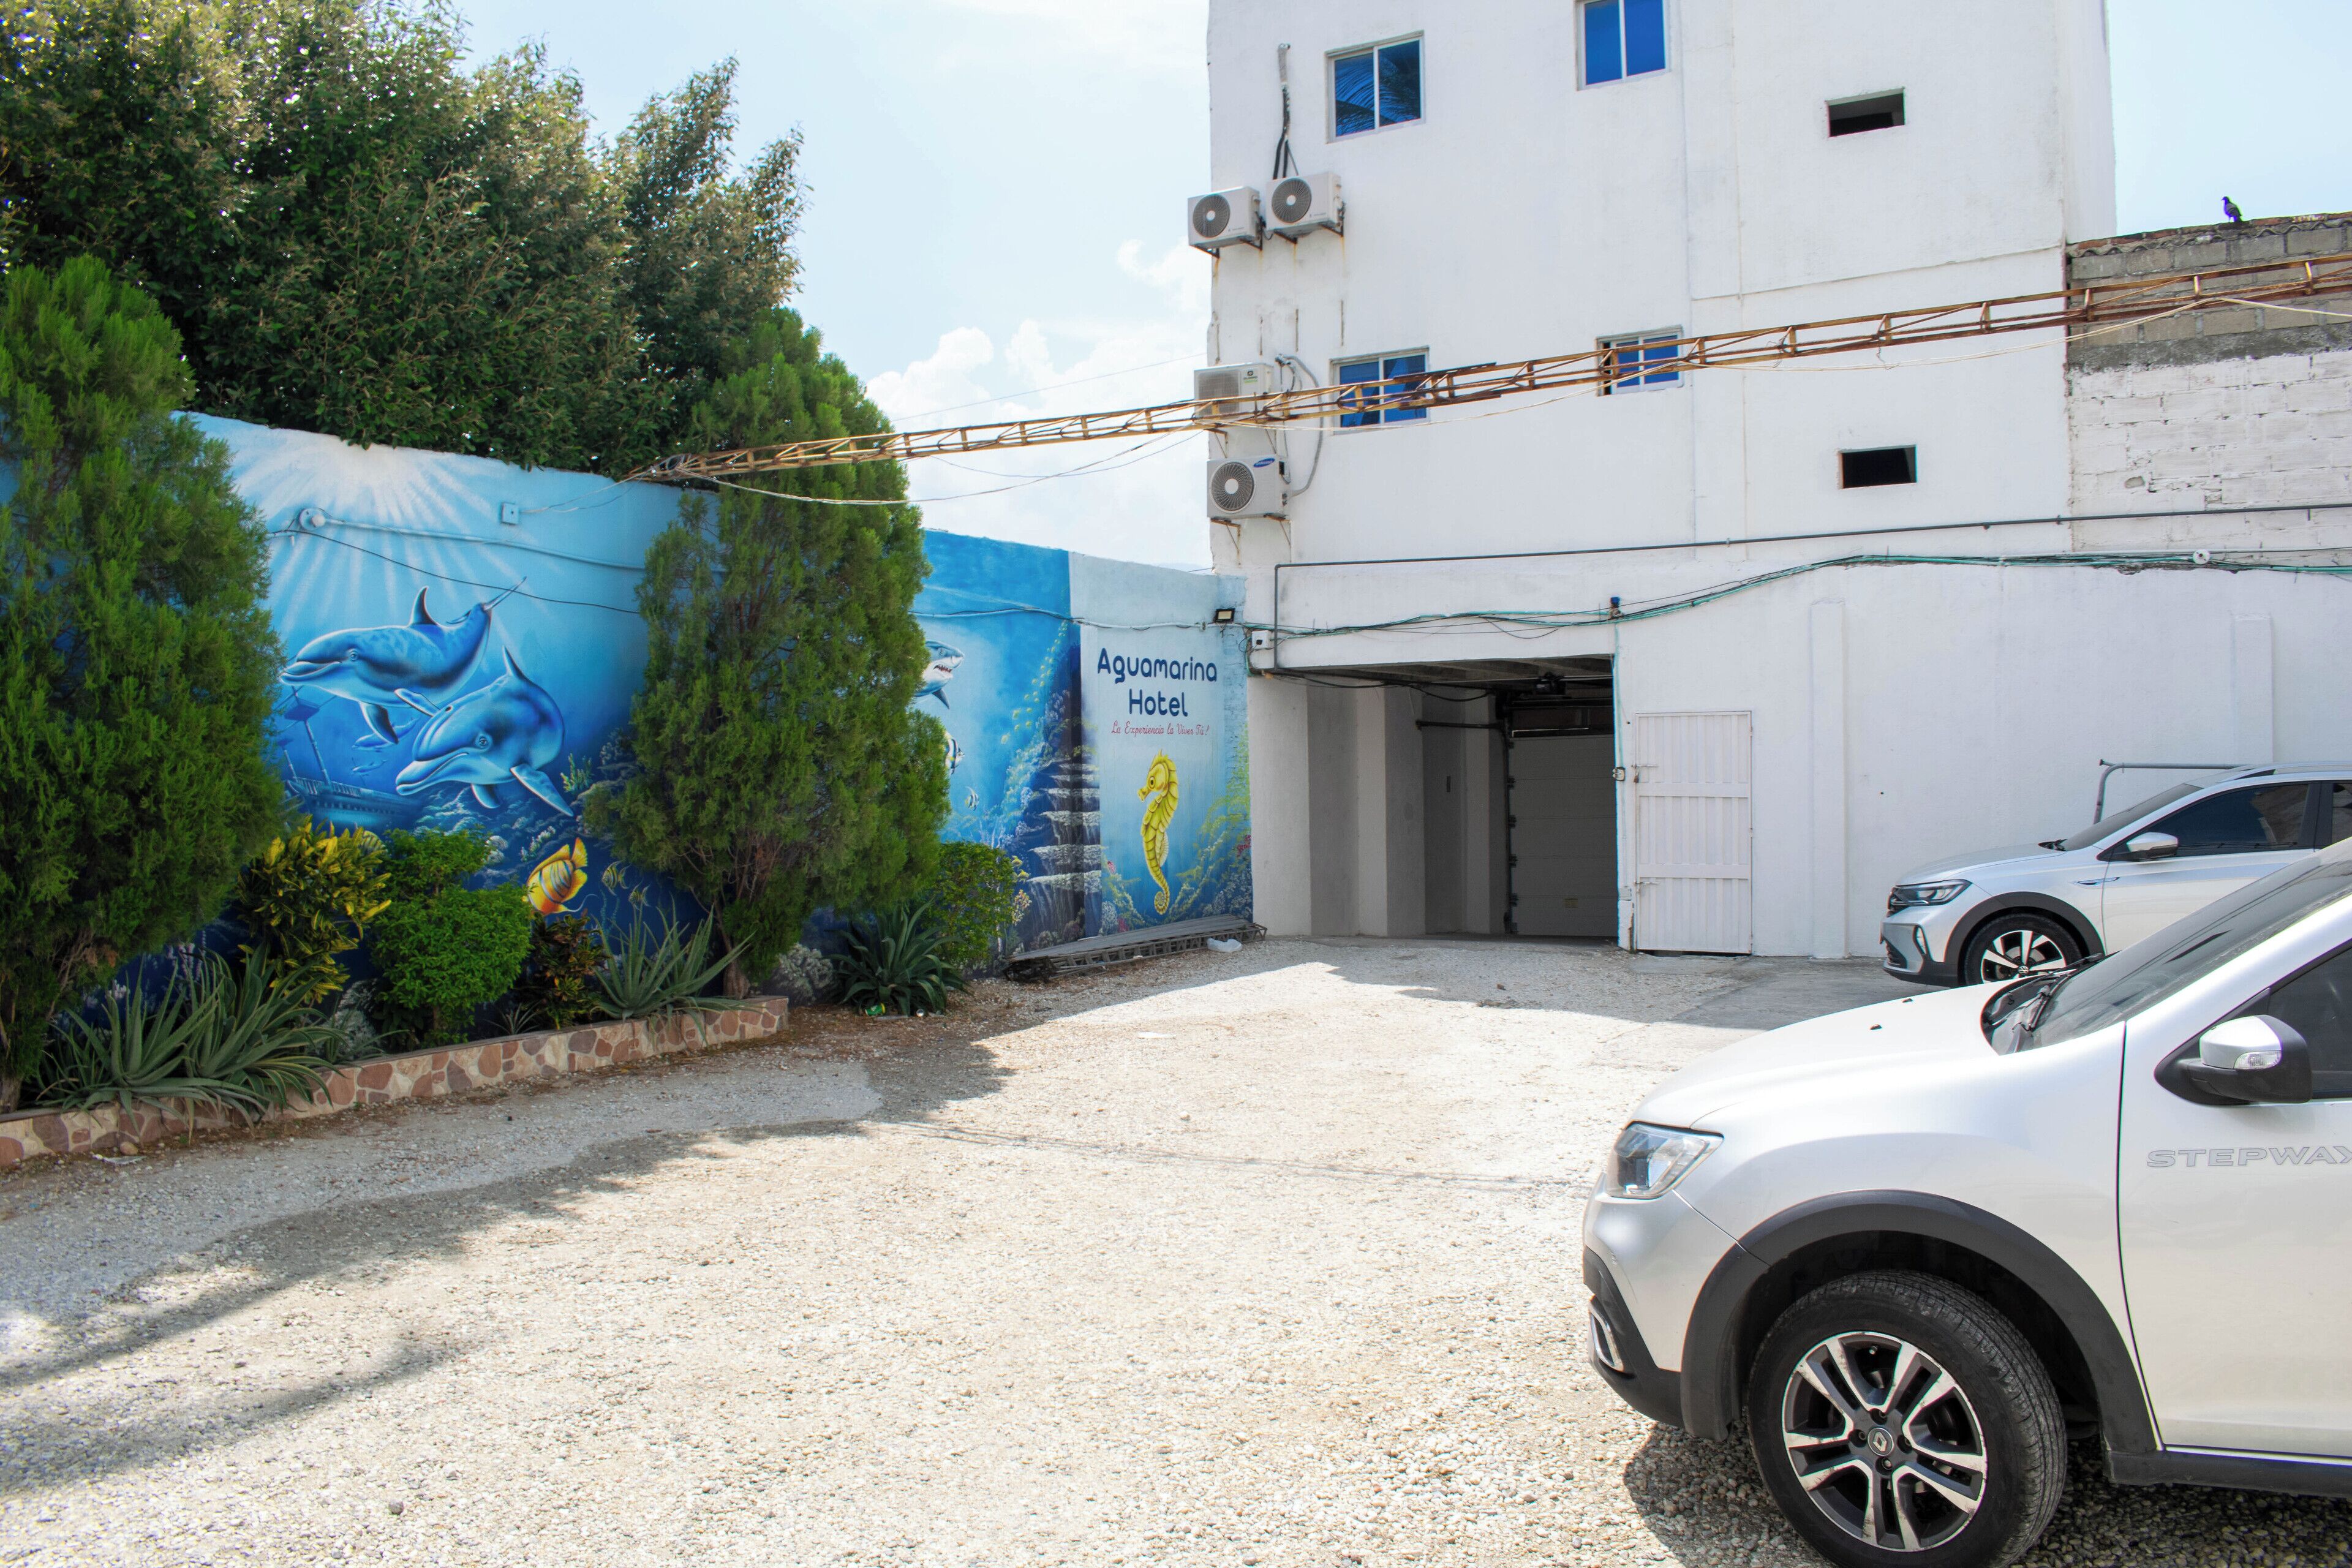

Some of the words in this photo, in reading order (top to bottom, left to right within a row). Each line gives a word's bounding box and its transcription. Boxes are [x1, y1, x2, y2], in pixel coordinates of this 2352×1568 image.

[1098, 647, 1217, 684] Aguamarina
[1129, 688, 1188, 717] Hotel
[1111, 720, 1121, 734] La
[1125, 721, 1164, 737] Experiencia
